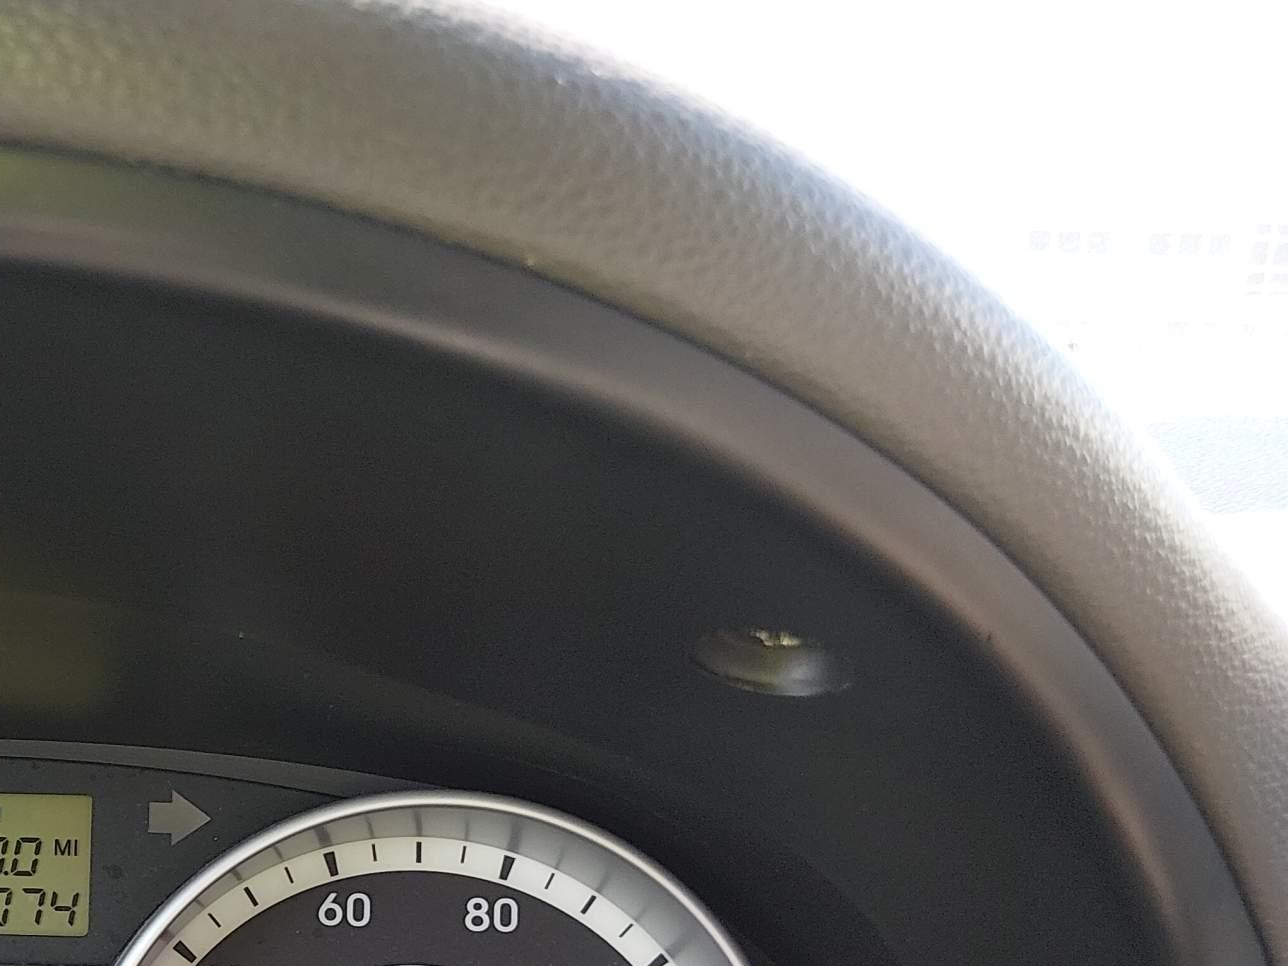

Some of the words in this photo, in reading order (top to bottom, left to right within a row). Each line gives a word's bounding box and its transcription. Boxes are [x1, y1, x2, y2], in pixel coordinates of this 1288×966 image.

[54, 838, 78, 857] MI
[317, 892, 372, 927] 60
[463, 897, 519, 933] 80
